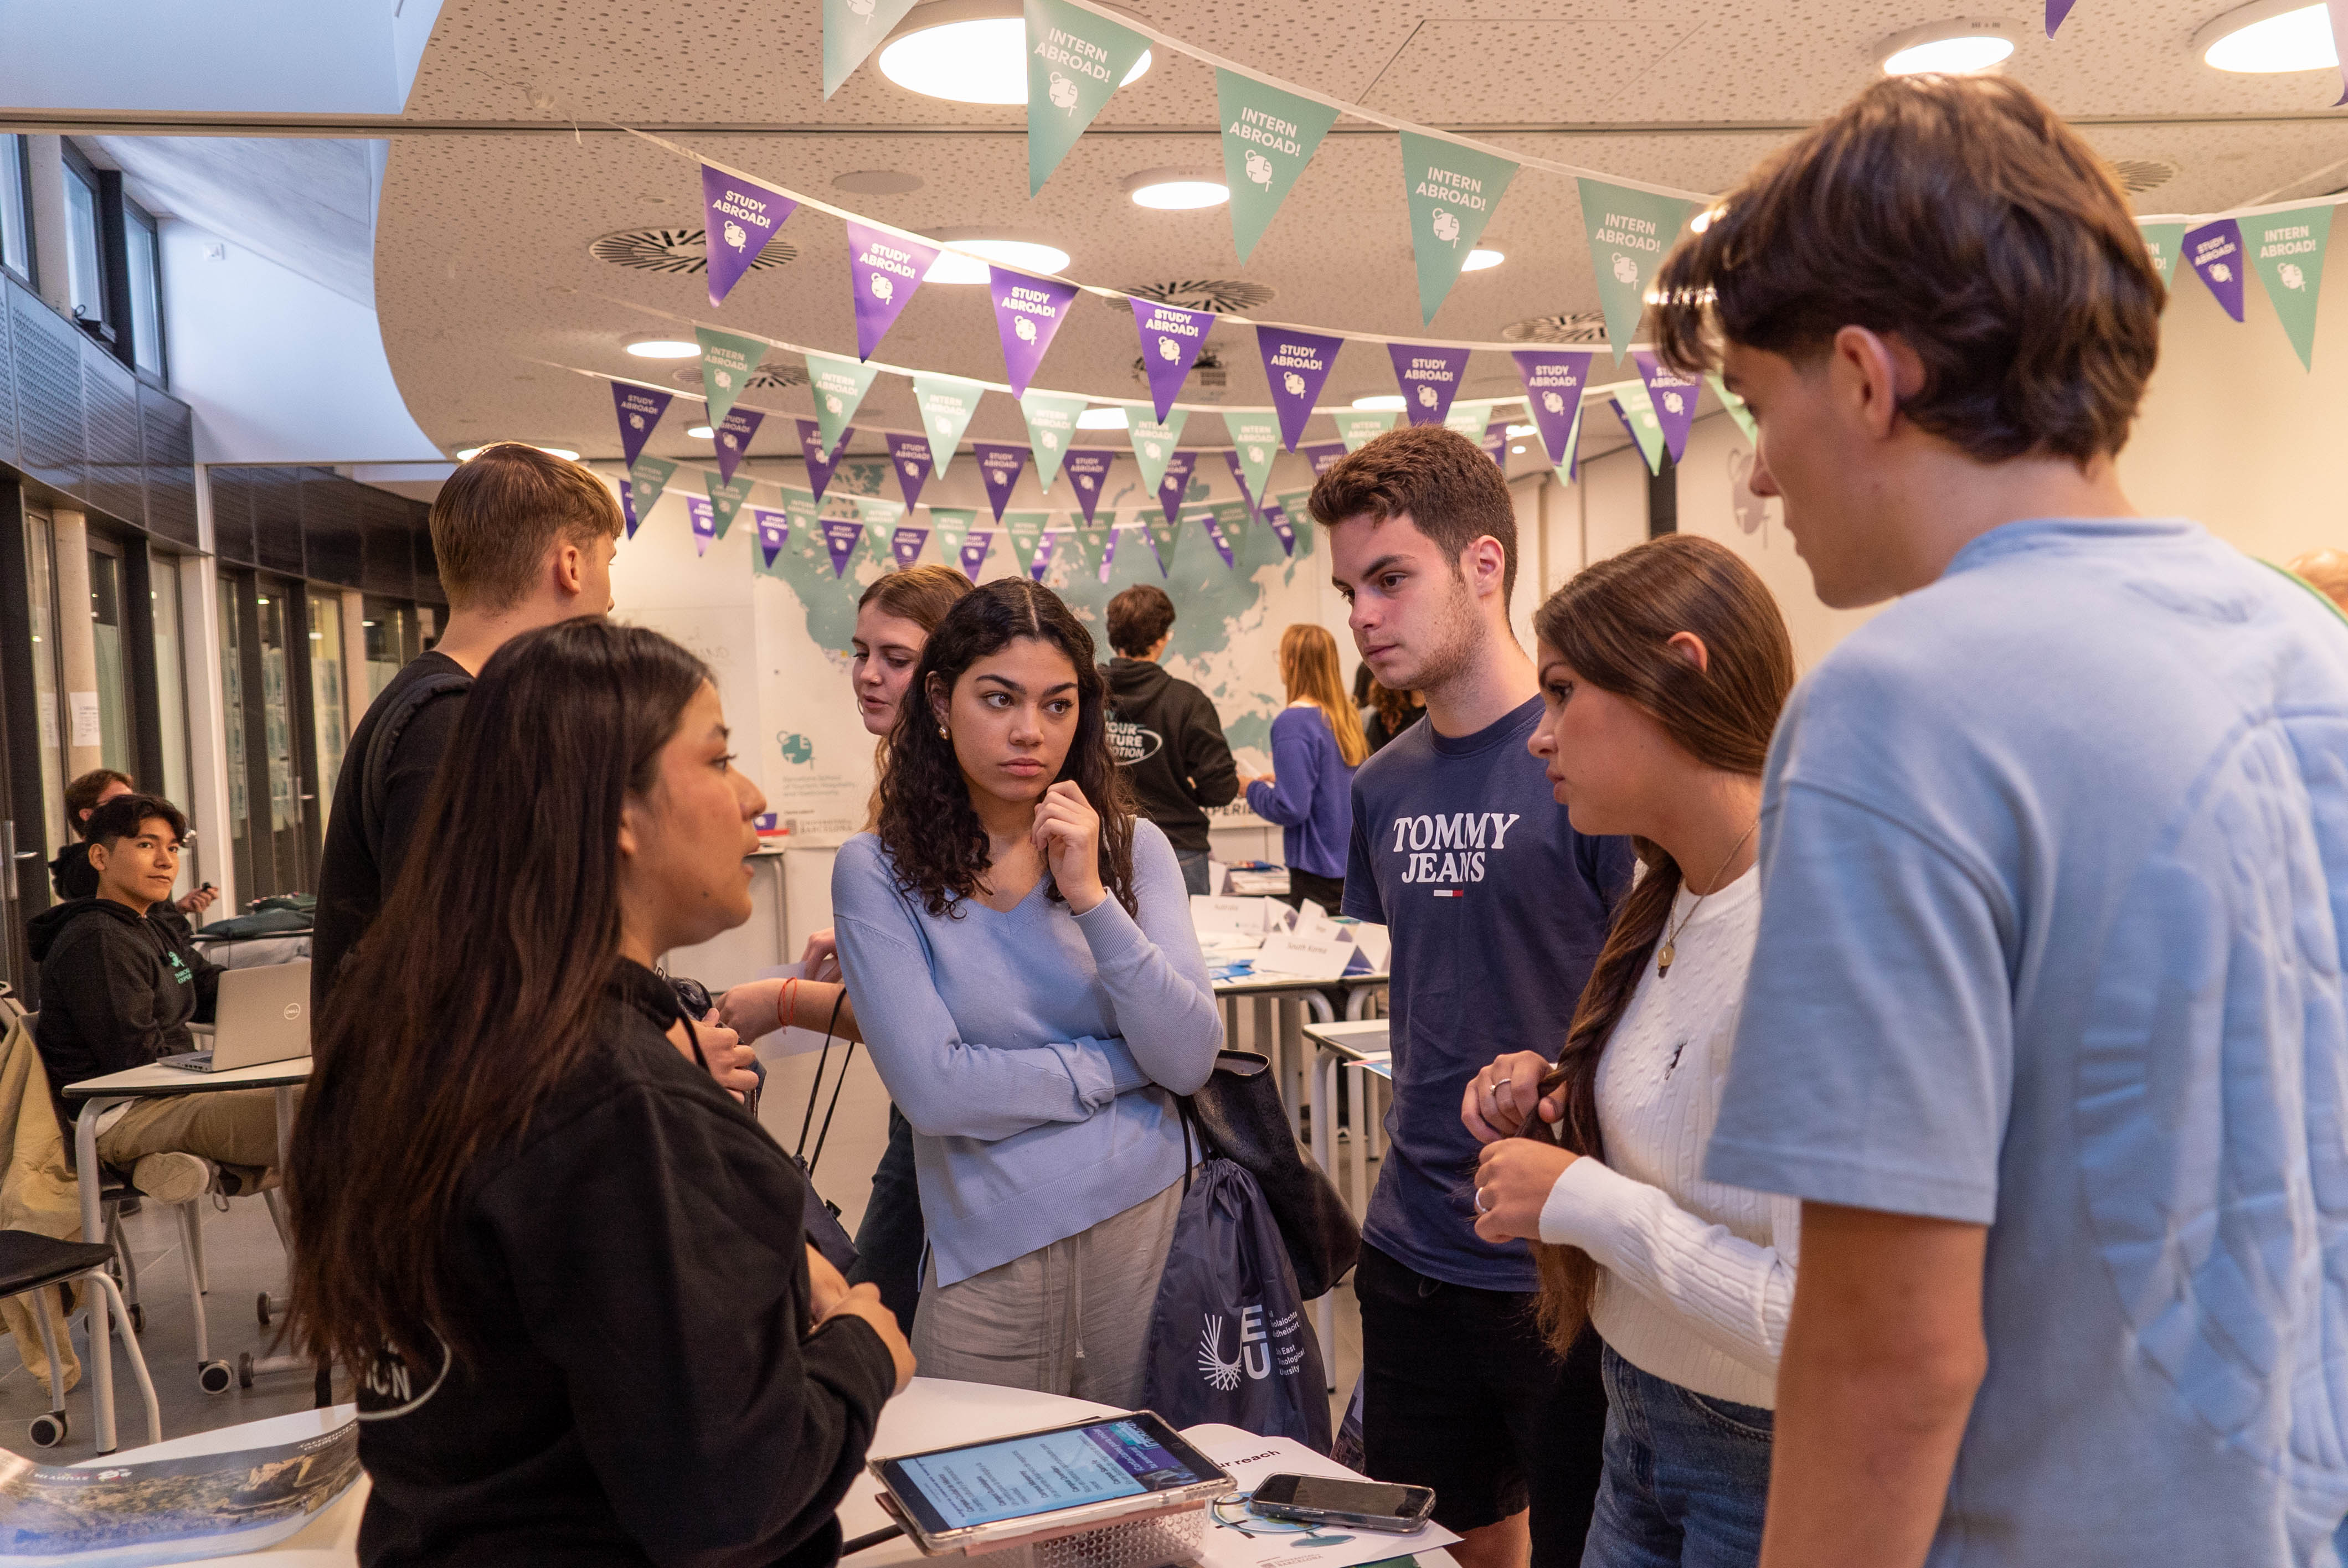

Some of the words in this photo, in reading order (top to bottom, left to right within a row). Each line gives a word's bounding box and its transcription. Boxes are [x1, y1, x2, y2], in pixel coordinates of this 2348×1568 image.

[1049, 28, 1108, 64] INTERN
[1034, 42, 1111, 82] ABROAD!
[1242, 107, 1297, 138] INTERN
[1229, 121, 1300, 157] ABROAD!
[1428, 167, 1481, 193] INTERN
[725, 190, 766, 213] STUDY
[1415, 182, 1486, 211] ABROAD!
[713, 199, 770, 228] ABROAD!
[1605, 213, 1656, 235] INTERN
[1595, 228, 1661, 252] ABROAD!
[2264, 226, 2309, 243] INTERN
[871, 243, 910, 264] STUDY
[2195, 242, 2236, 266] ABROAD!
[2197, 235, 2225, 254] STUDY
[2261, 240, 2316, 259] ABROAD!
[859, 252, 915, 278] ABROAD!
[1011, 286, 1049, 303] STUDY
[1001, 297, 1055, 317] ABROAD!
[1155, 309, 1191, 324] STUDY
[1145, 318, 1198, 337] ABROAD!
[711, 347, 745, 360] INTERN
[1280, 344, 1316, 358] STUDY
[704, 355, 747, 372] ABROAD!
[1271, 355, 1322, 370] ABROAD!
[1412, 358, 1446, 369] STUDY
[1536, 365, 1569, 375] STUDY
[822, 373, 855, 386] INTERN
[1404, 369, 1453, 381] ABROAD!
[1529, 376, 1577, 386] ABROAD!
[816, 381, 858, 396] ABROAD!
[621, 401, 658, 414] ABROAD!
[628, 395, 654, 406] STUDY
[1393, 813, 1520, 852] TOMMY
[1402, 852, 1485, 883] JEANS
[1281, 1344, 1295, 1355] East
[1234, 1451, 1280, 1465] reach
